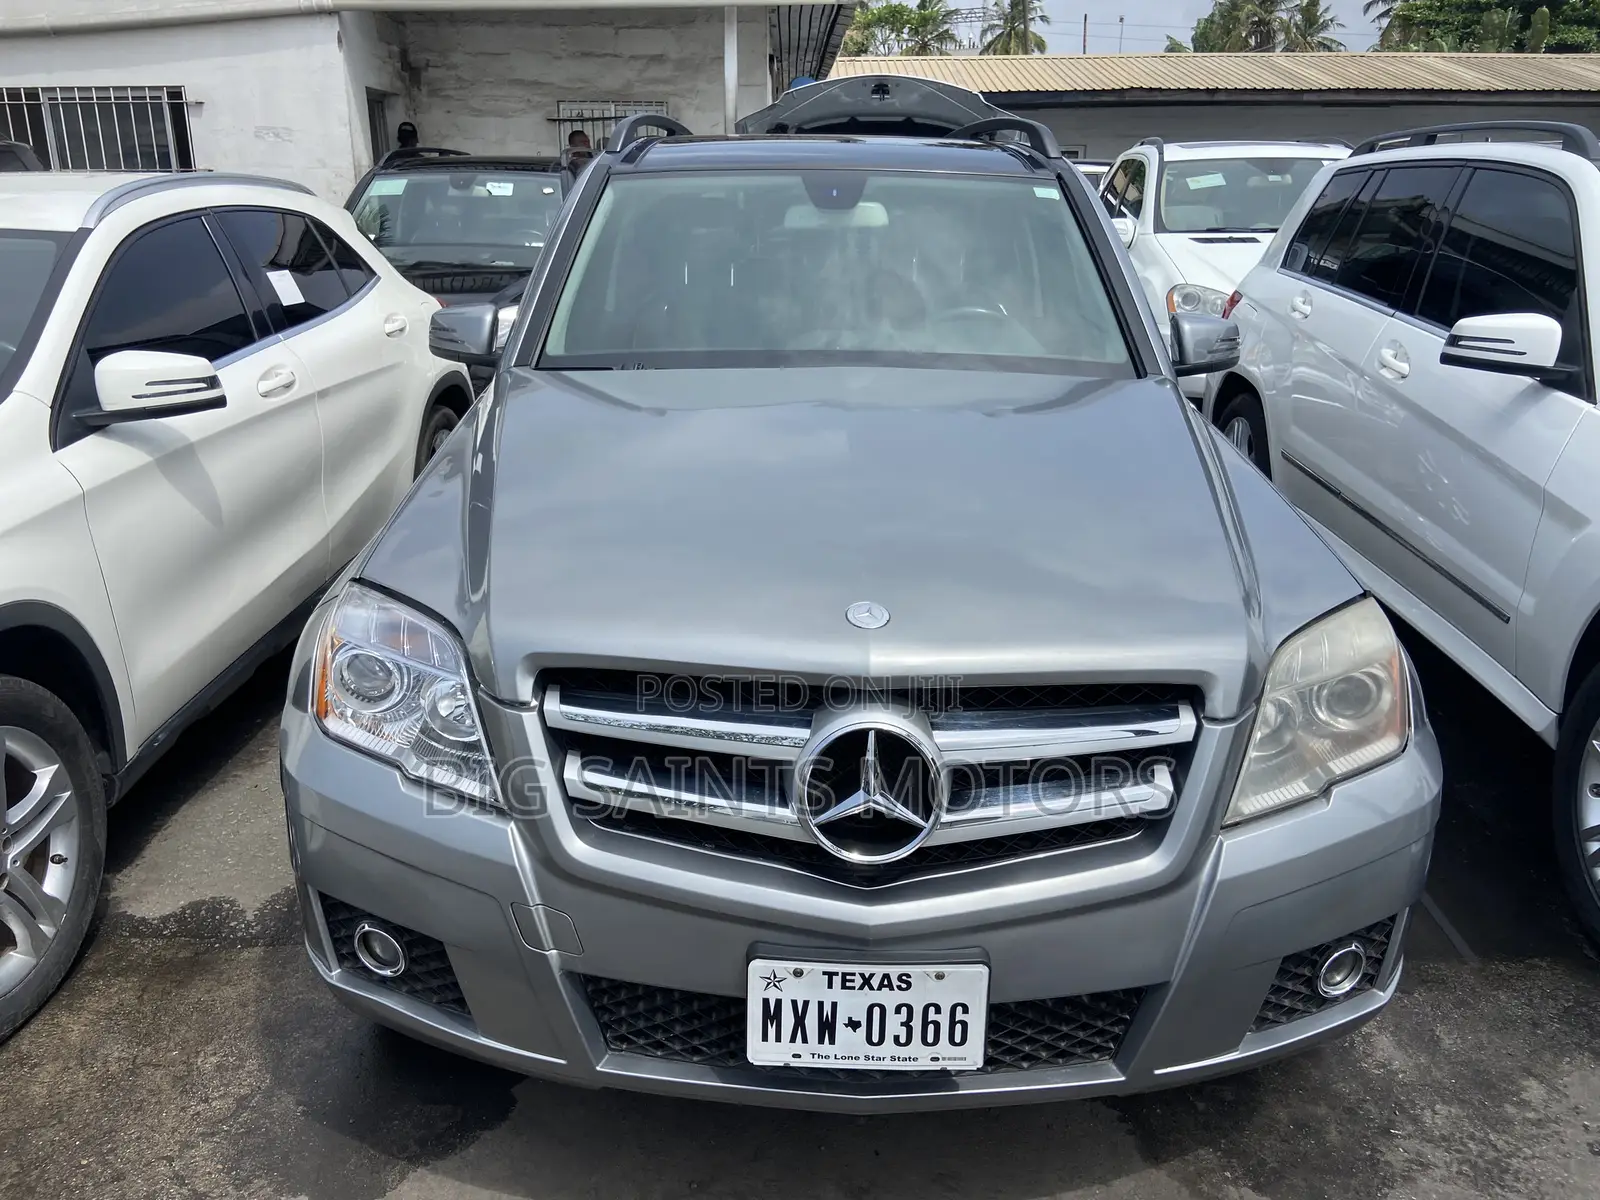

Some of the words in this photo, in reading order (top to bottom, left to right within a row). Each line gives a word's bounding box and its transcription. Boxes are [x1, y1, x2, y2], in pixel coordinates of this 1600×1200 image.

[822, 971, 912, 992] TEXAS
[761, 997, 838, 1045] MXW
[865, 1002, 970, 1047] 0366
[834, 1053, 862, 1062] Lone
[864, 1054, 887, 1062] Star
